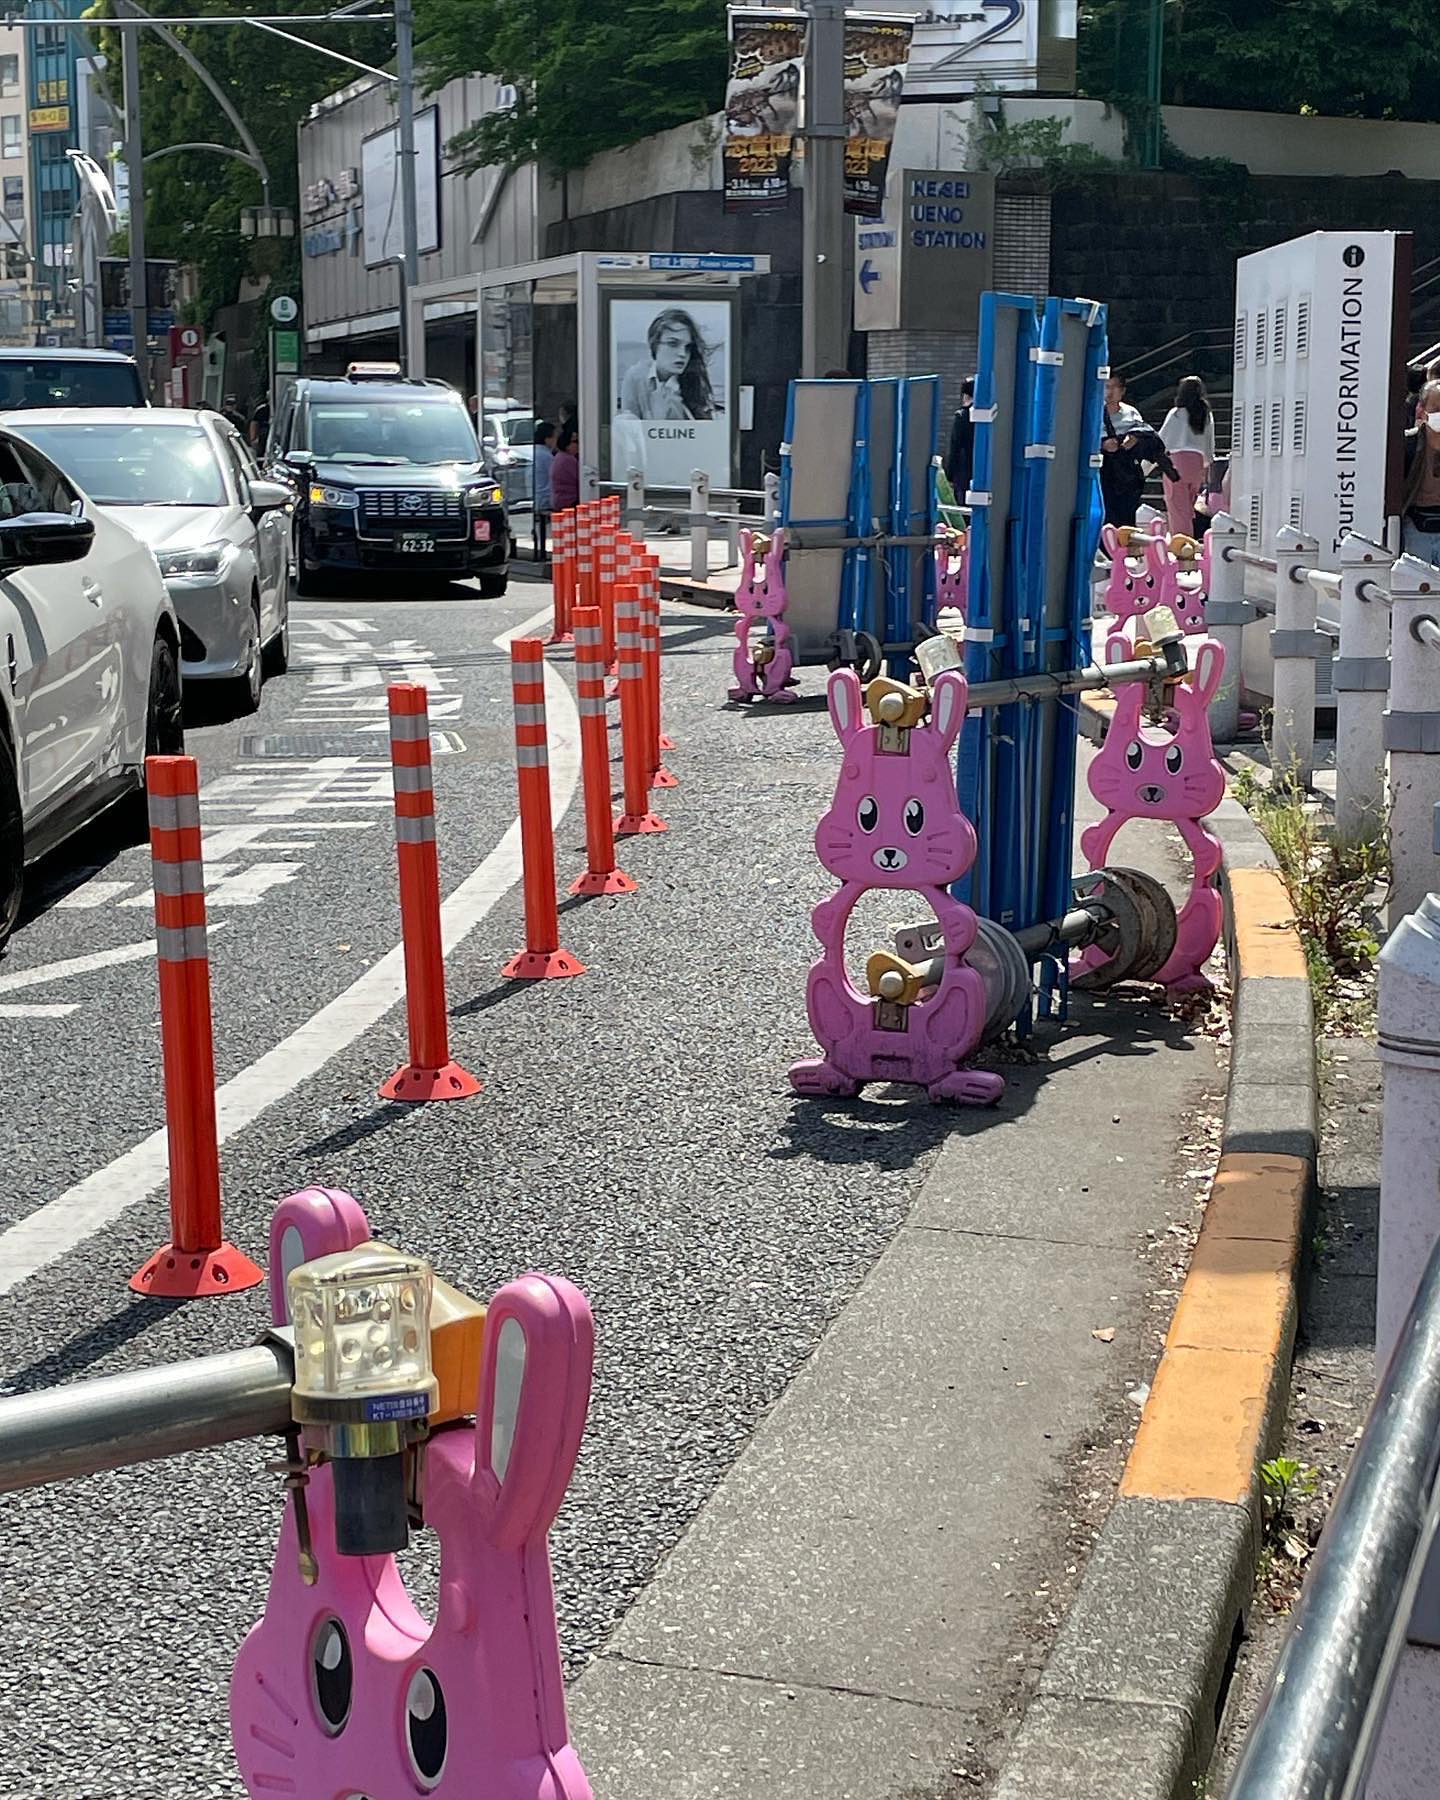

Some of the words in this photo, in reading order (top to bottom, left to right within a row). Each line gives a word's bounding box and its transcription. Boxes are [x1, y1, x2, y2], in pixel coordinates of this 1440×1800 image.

[738, 157, 777, 173] 2023
[845, 154, 869, 175] 023
[911, 180, 971, 199] KEISEI
[911, 204, 963, 224] UENO
[911, 230, 987, 249] STATION
[1335, 277, 1363, 462] INFORMATION
[647, 427, 696, 440] CELINE
[1332, 471, 1357, 553] Tourist
[402, 540, 435, 553] 62-32
